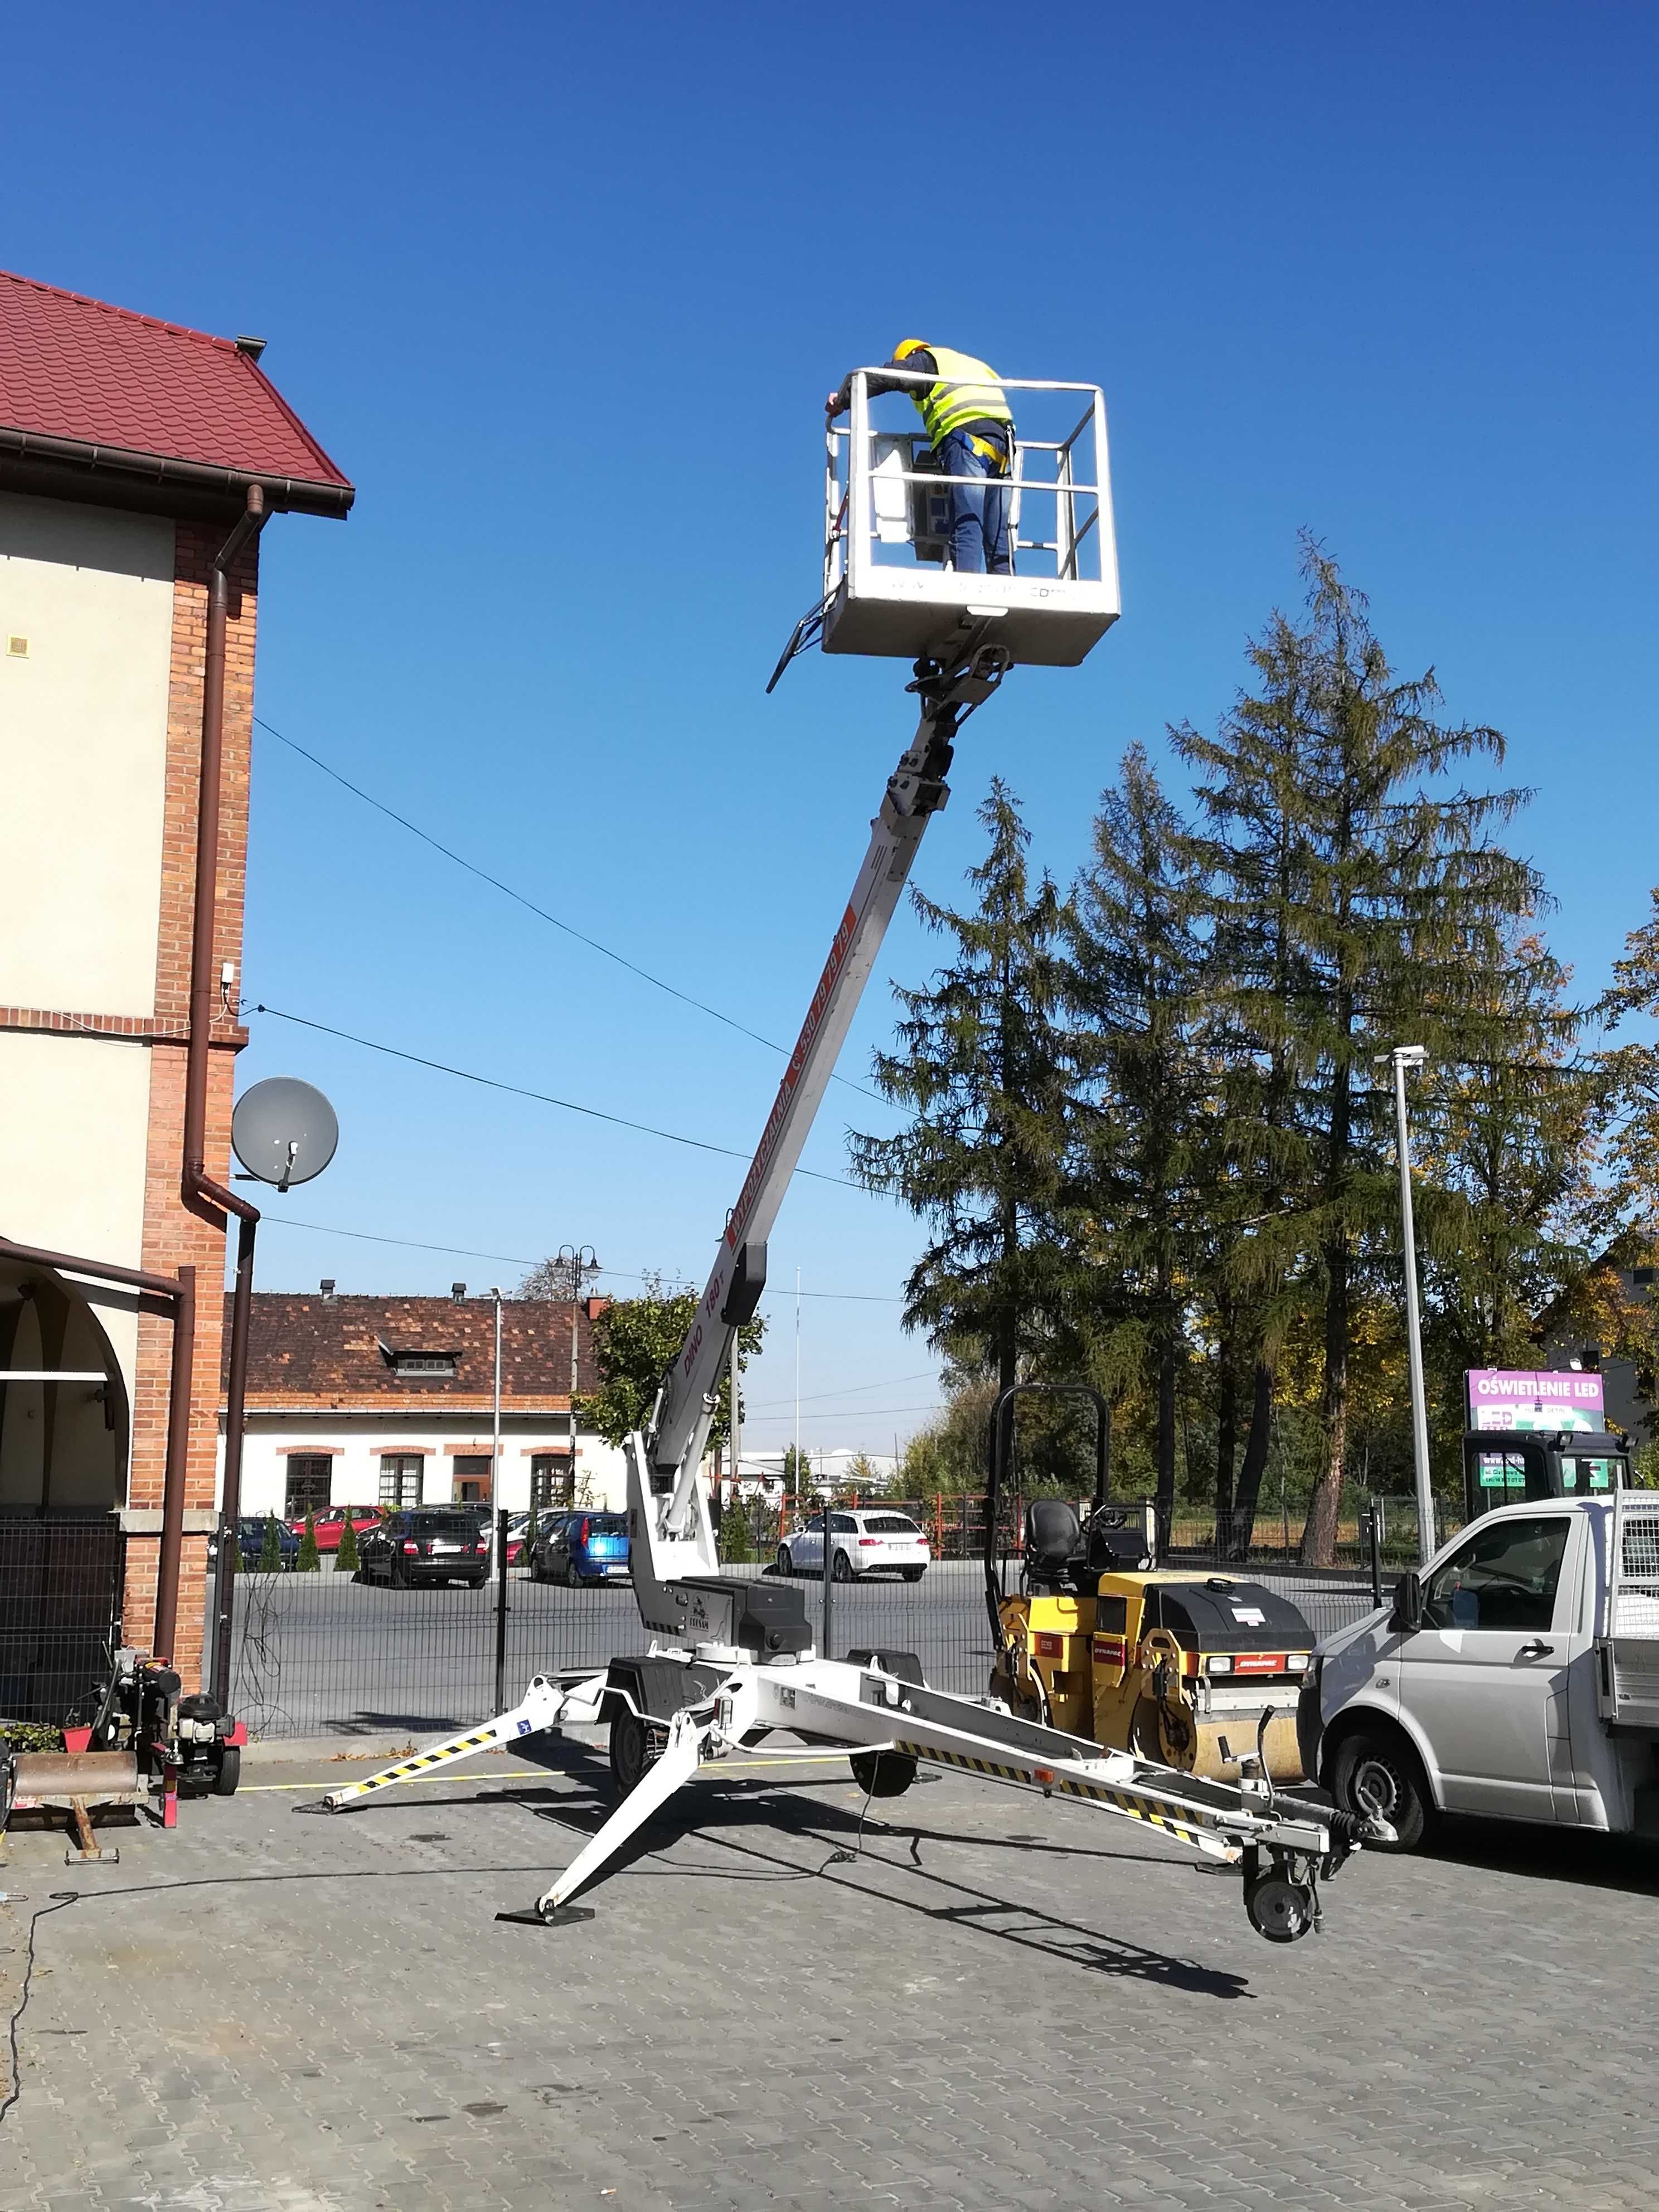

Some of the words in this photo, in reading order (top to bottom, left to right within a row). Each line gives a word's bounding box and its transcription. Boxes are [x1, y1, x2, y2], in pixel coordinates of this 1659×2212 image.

[799, 1013, 816, 1054] 530
[814, 984, 827, 1013] 79
[826, 952, 837, 983] 79
[836, 921, 850, 954] 79
[684, 1324, 702, 1379] DINO
[1478, 1375, 1571, 1398] OŚWIETLENIE
[1574, 1382, 1599, 1398] LED
